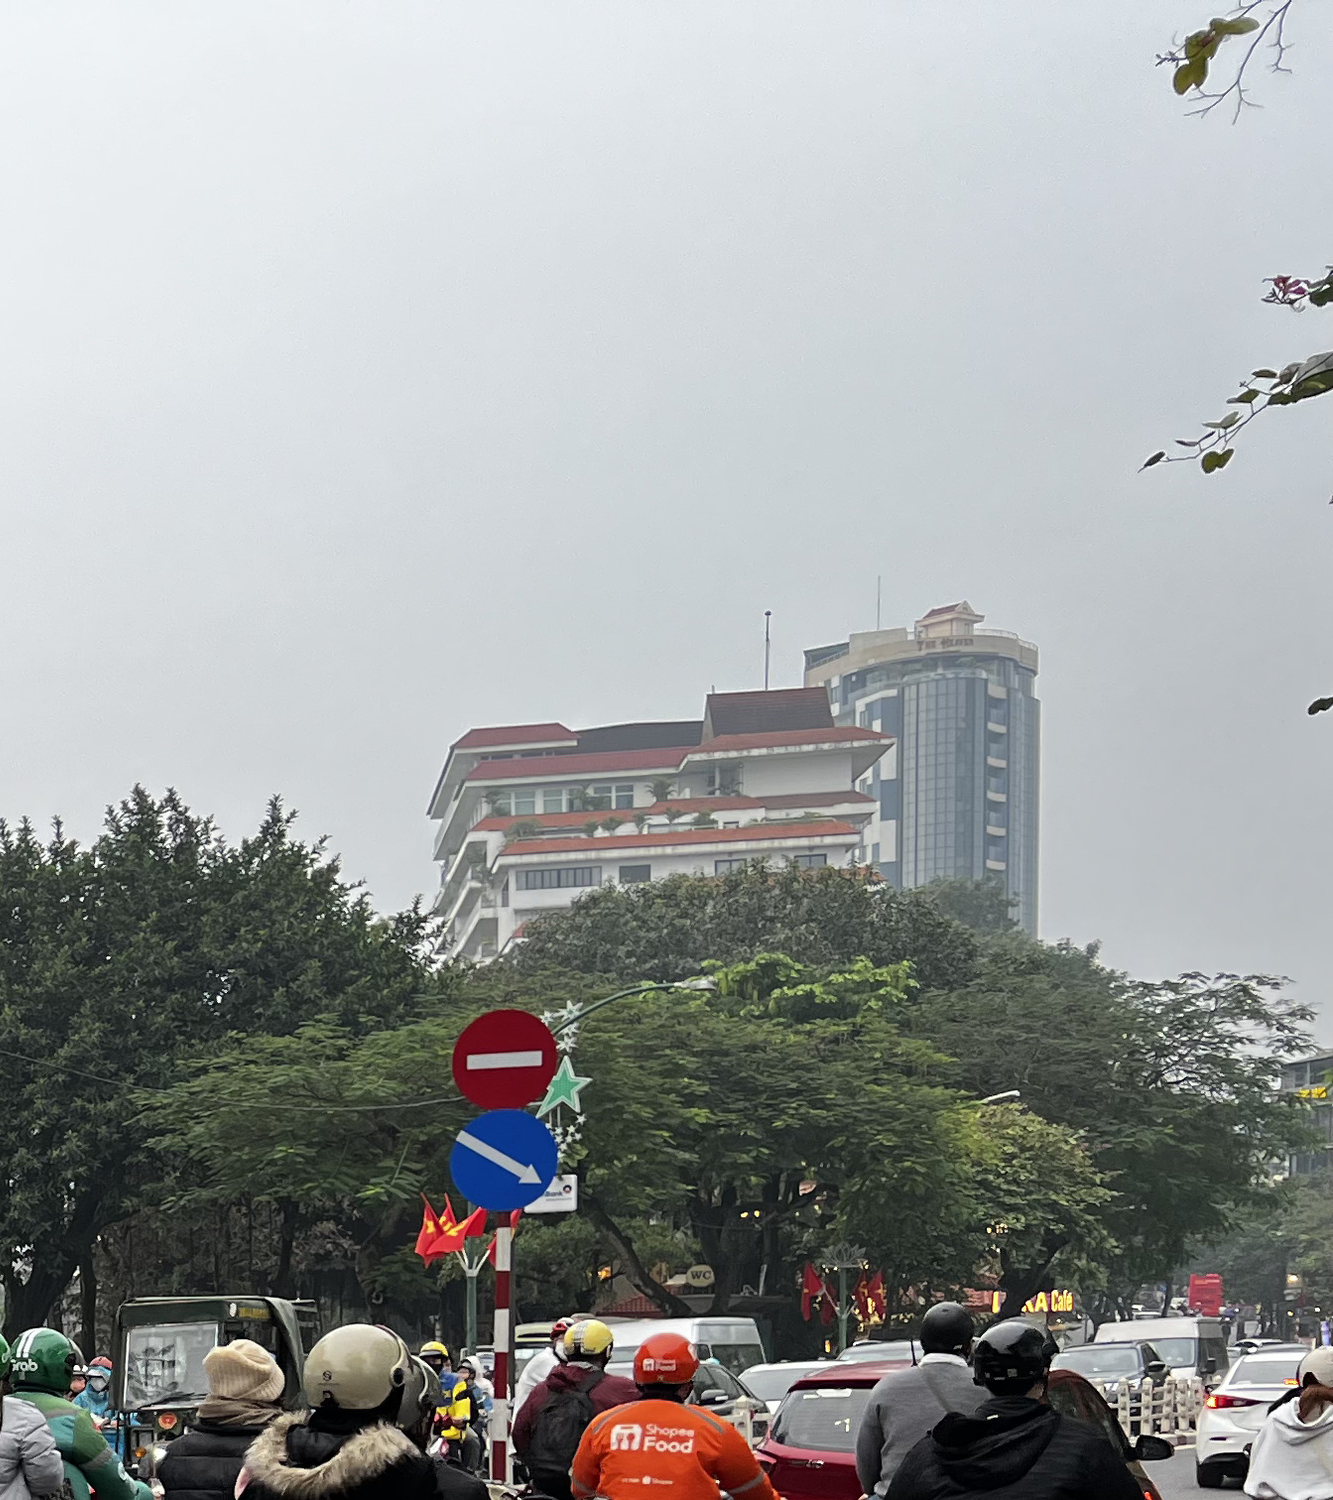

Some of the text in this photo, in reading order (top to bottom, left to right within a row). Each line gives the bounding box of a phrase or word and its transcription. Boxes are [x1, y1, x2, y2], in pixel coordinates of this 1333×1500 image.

[690, 1270, 712, 1280] WC
[1050, 1289, 1073, 1312] Café
[645, 1423, 695, 1438] Shopee
[643, 1436, 693, 1453] Food
